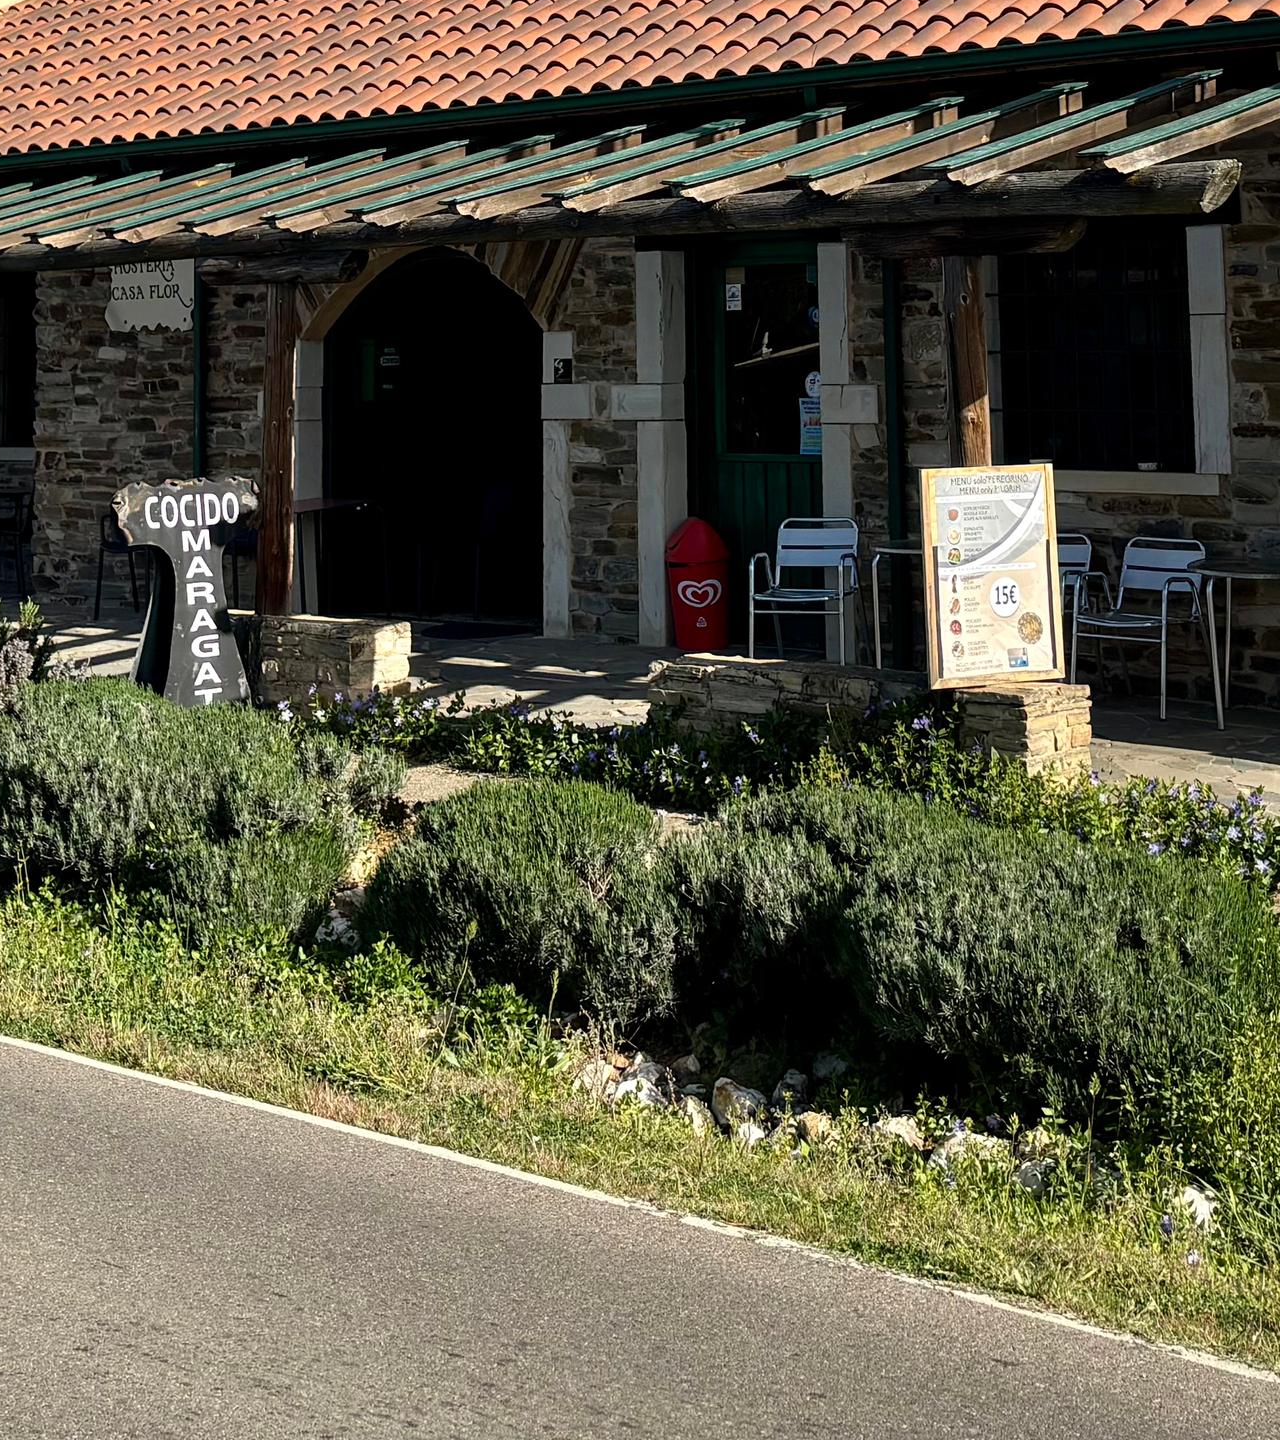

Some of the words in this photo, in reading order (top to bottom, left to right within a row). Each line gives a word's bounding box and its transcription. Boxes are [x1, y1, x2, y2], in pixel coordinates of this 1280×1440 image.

[112, 285, 145, 301] CASA
[149, 283, 193, 308] FLOR
[950, 477, 972, 486] MENU
[959, 486, 980, 495] MENU
[144, 492, 239, 530] COCIDO
[995, 585, 1017, 605] 15€
[181, 528, 223, 707] MARAGAT
